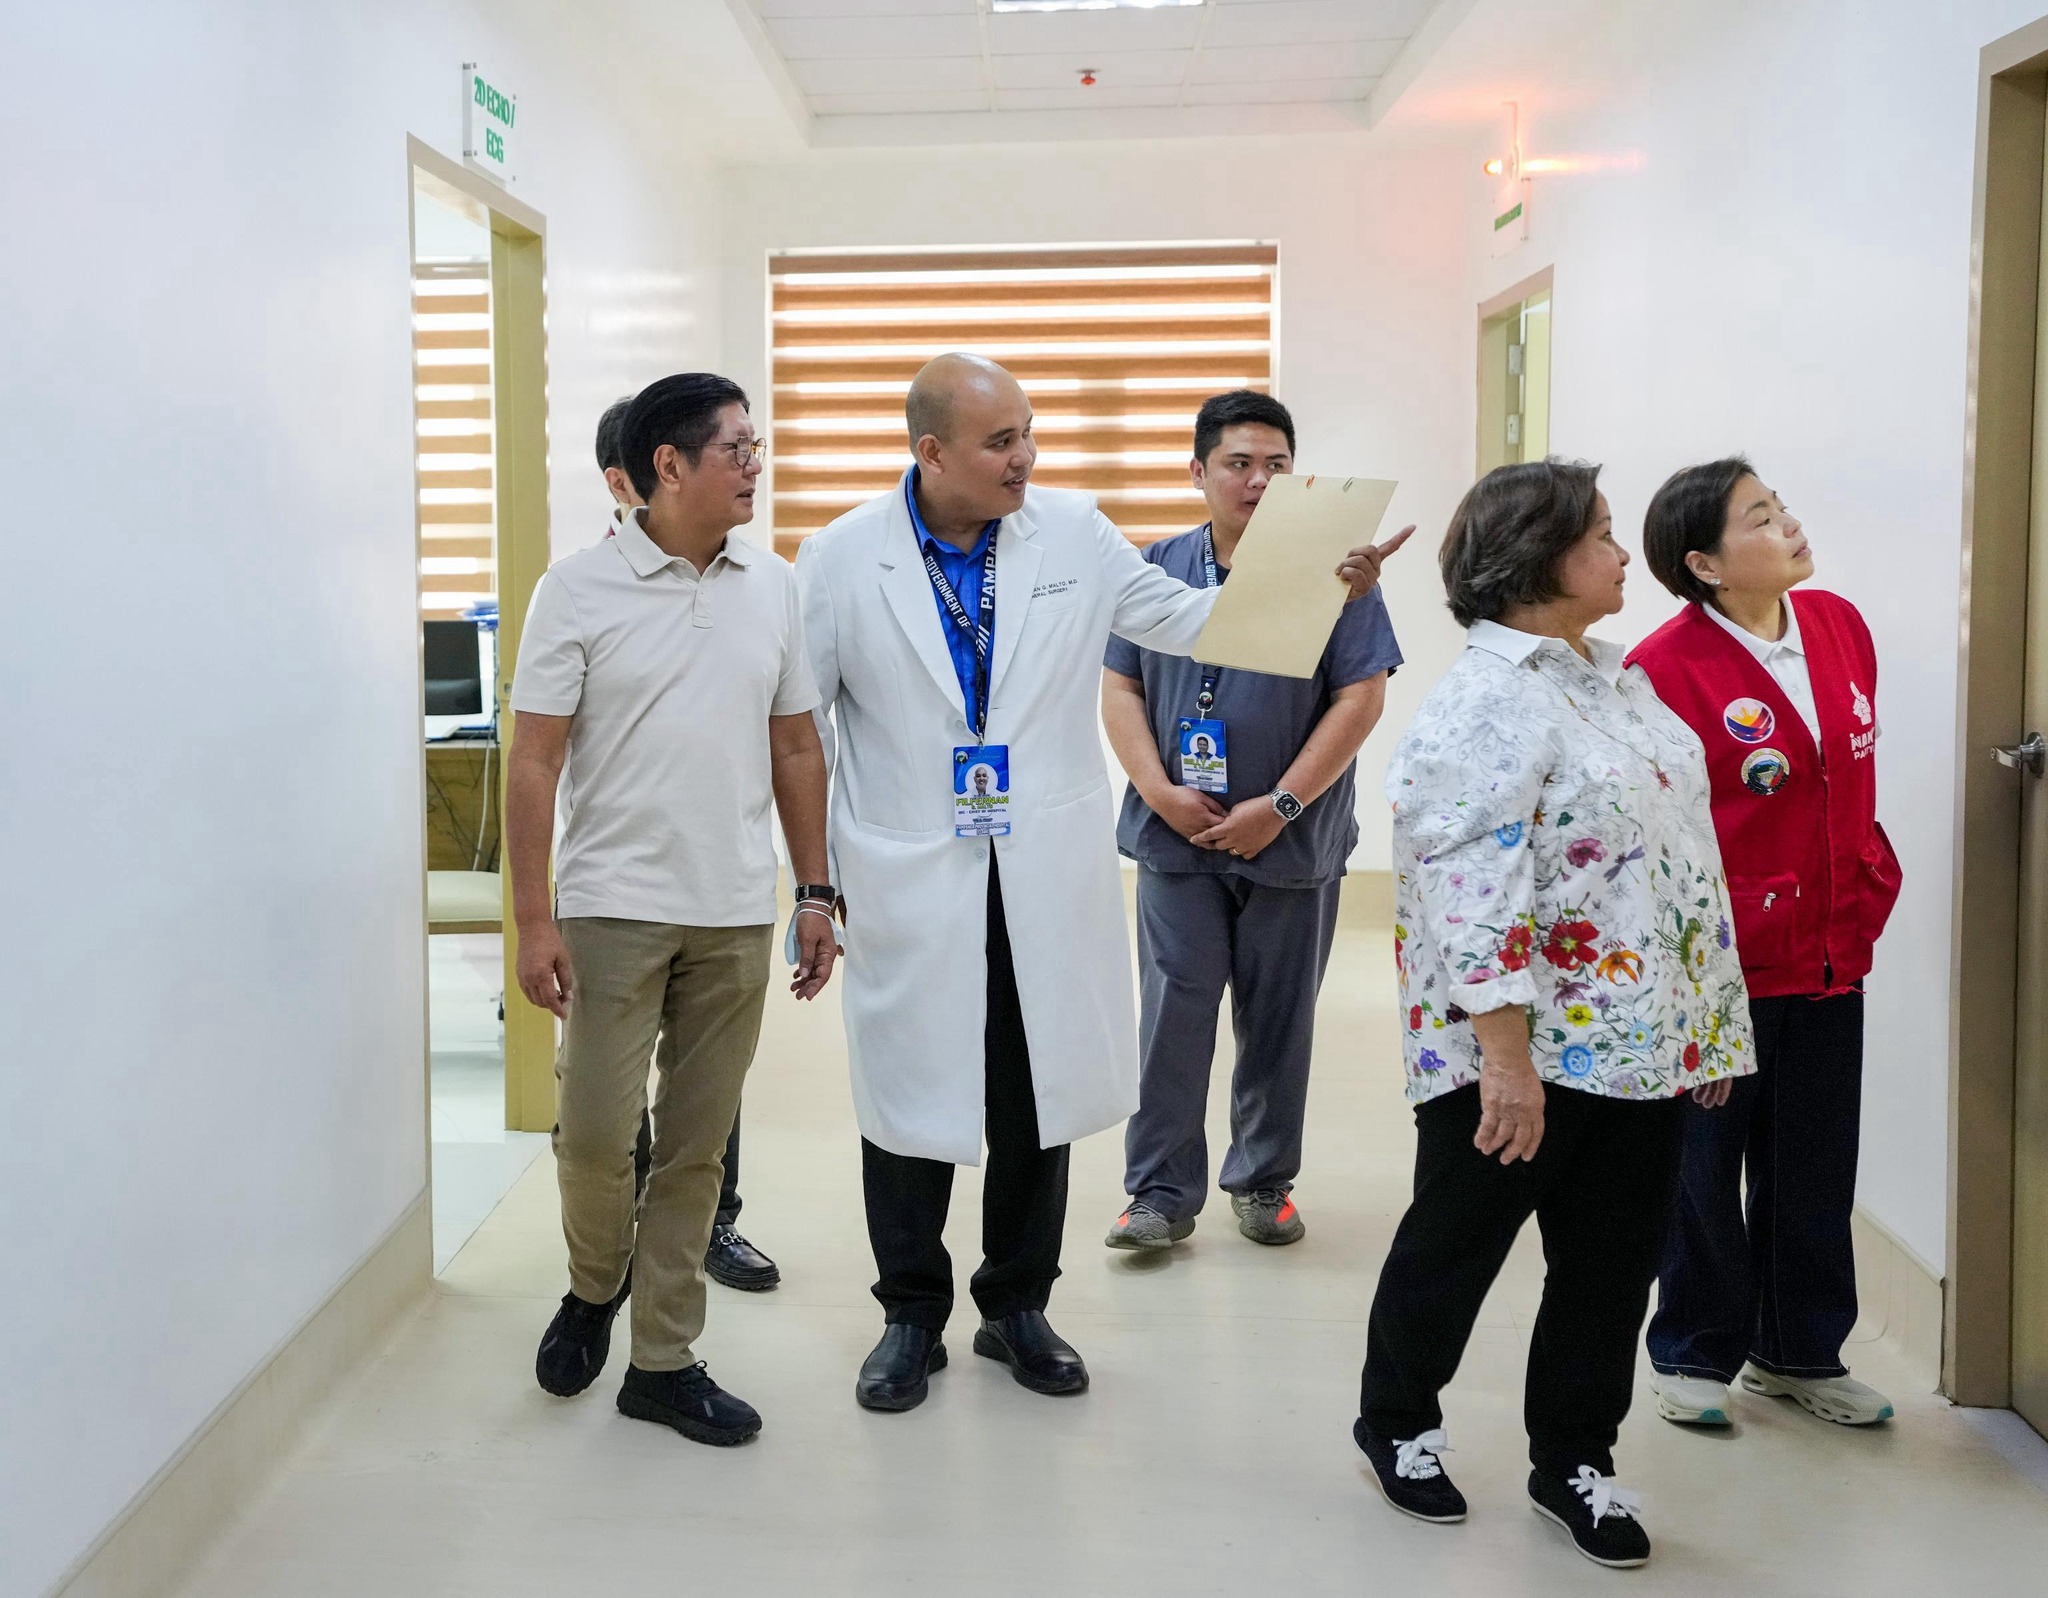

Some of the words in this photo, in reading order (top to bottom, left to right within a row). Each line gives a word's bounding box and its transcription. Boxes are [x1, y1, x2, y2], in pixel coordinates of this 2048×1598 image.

[474, 76, 485, 107] 2D
[486, 84, 510, 125] ECHO
[486, 127, 504, 164] ECG
[924, 555, 964, 616] GOVERNMENT
[957, 615, 971, 628] OF
